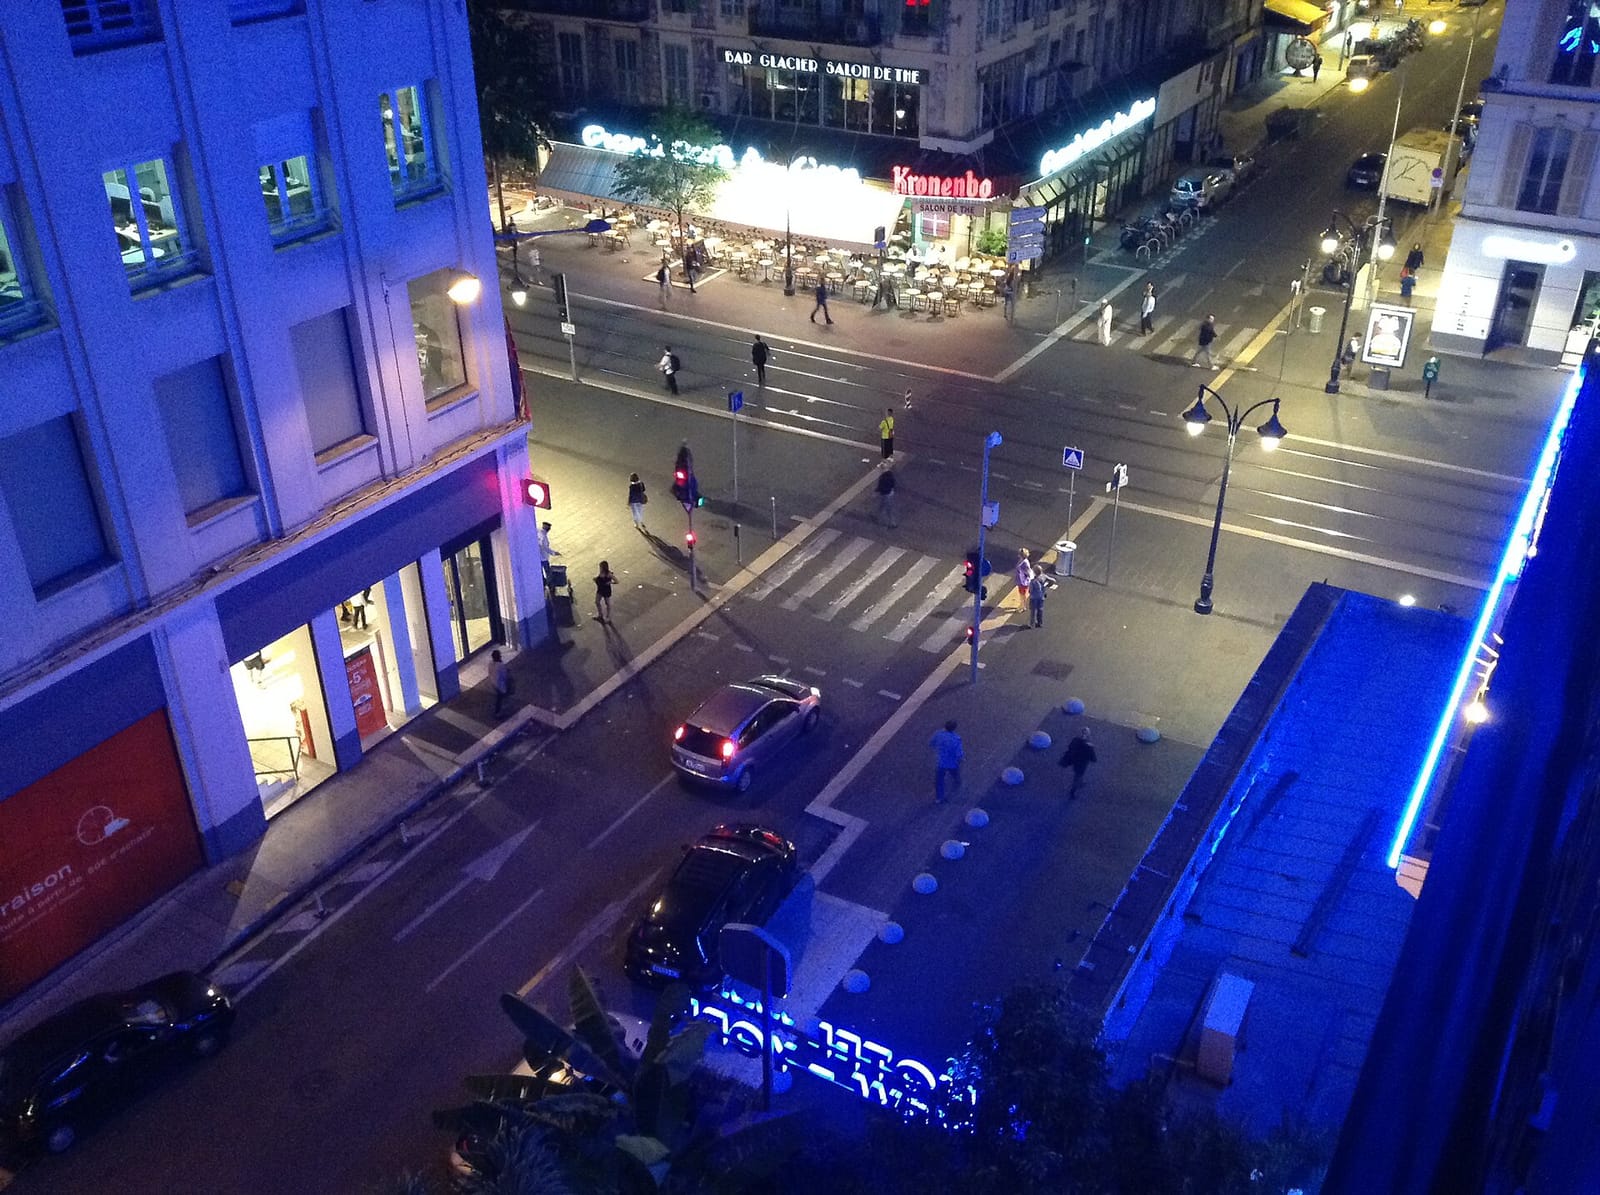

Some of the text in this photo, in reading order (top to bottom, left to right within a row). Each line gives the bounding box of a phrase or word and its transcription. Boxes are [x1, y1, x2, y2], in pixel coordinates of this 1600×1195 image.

[724, 50, 920, 84] BAR GLACIER SALON DE THE
[891, 165, 993, 198] Kronenbo
[919, 204, 975, 214] SALON DE THE
